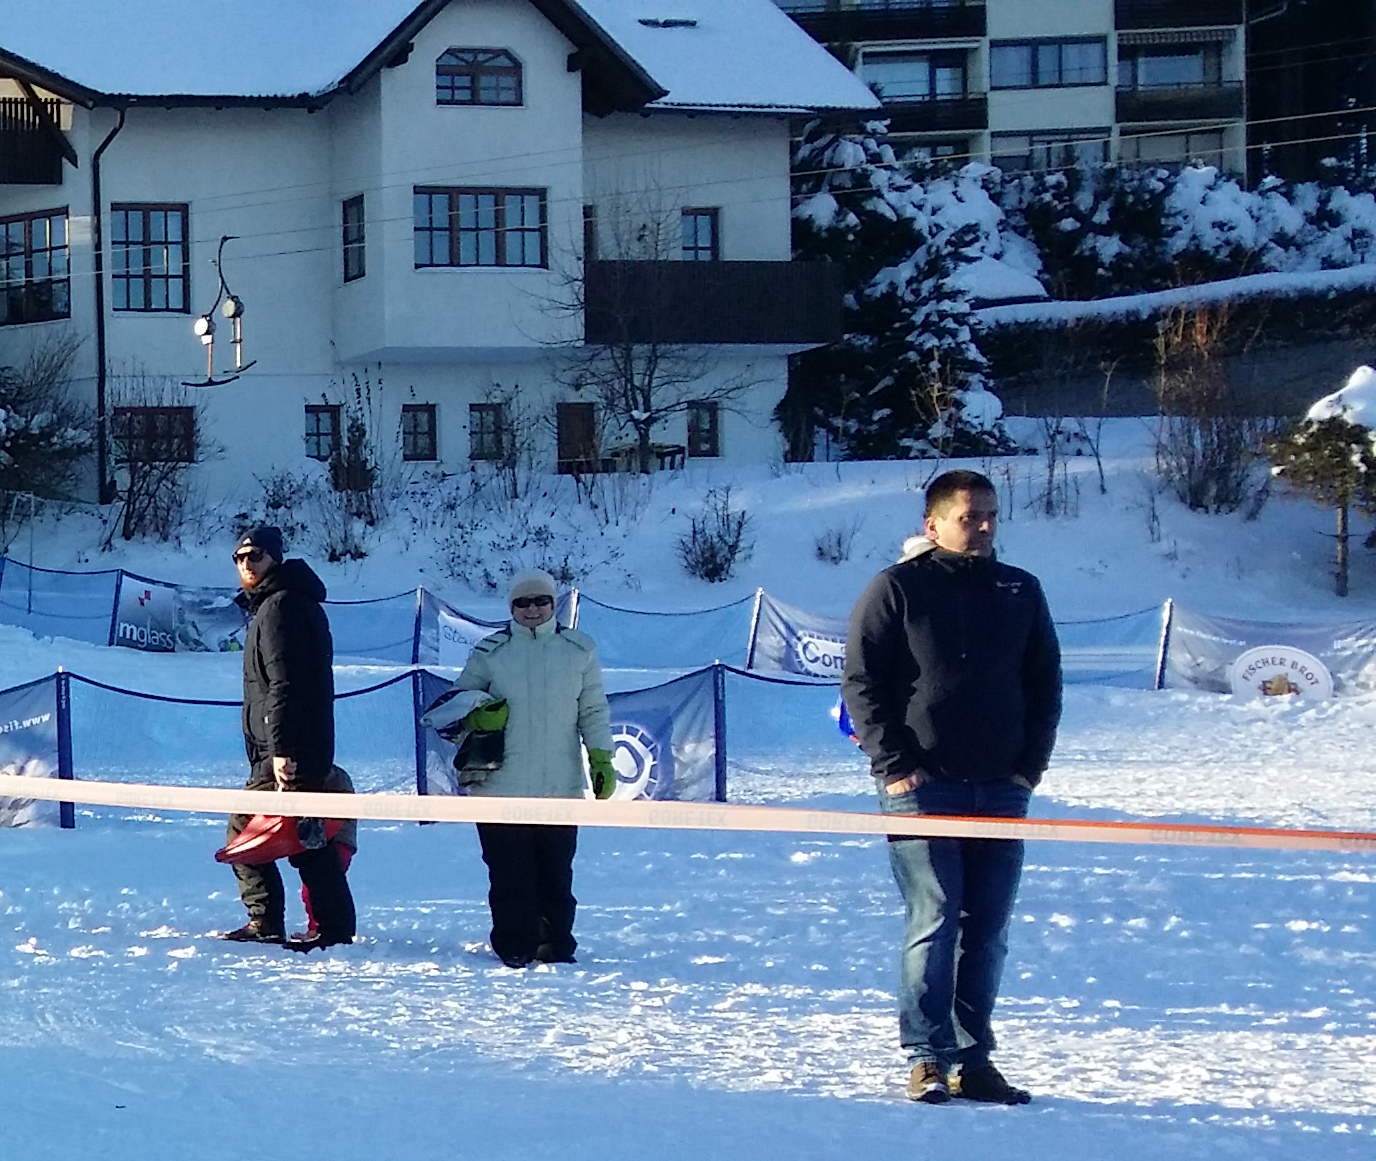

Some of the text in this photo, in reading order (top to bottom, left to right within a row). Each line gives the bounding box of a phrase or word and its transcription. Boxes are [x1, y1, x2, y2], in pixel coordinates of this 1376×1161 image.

[118, 622, 175, 650] mglass
[1242, 656, 1320, 687] FISCHER BROT
